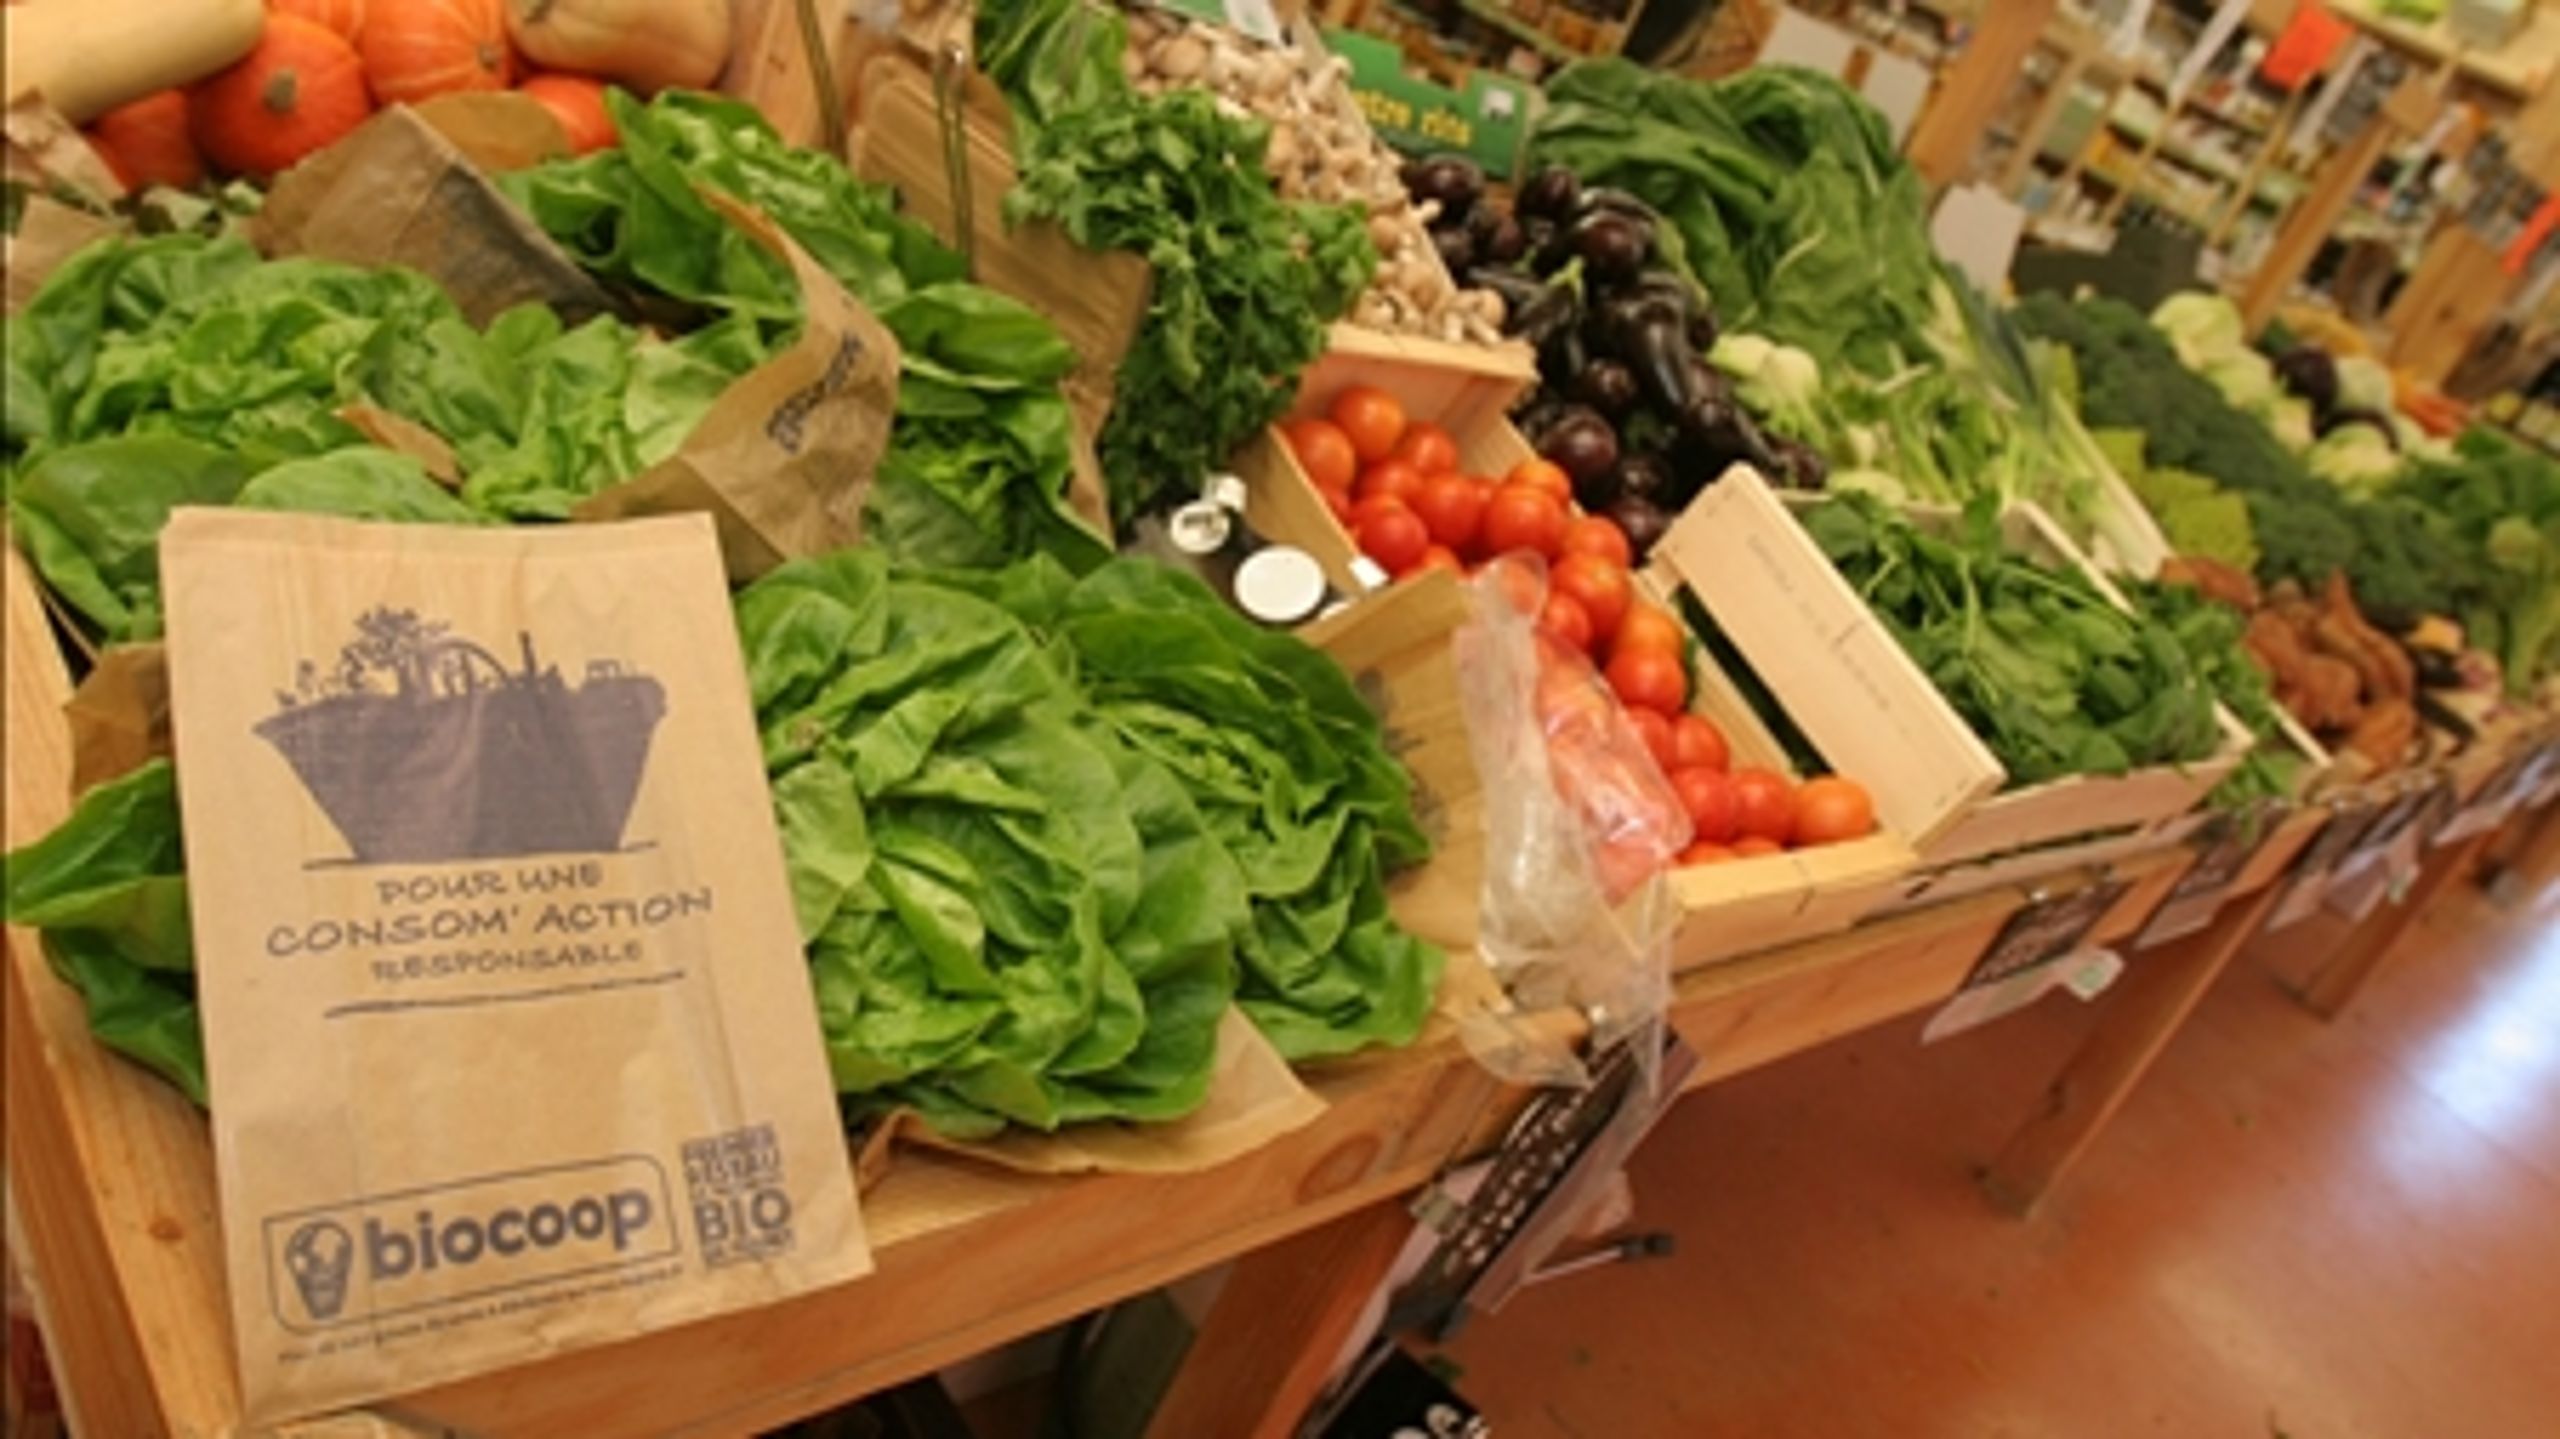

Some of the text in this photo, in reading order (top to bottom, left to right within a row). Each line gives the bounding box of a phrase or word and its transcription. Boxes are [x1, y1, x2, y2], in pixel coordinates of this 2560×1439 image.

[376, 863, 603, 904] POUR UNE
[266, 887, 714, 956] CONSOM' ACTION
[371, 941, 643, 982] RESPONSABLE
[364, 1188, 653, 1280] biocoop
[694, 1187, 792, 1243] BIO
